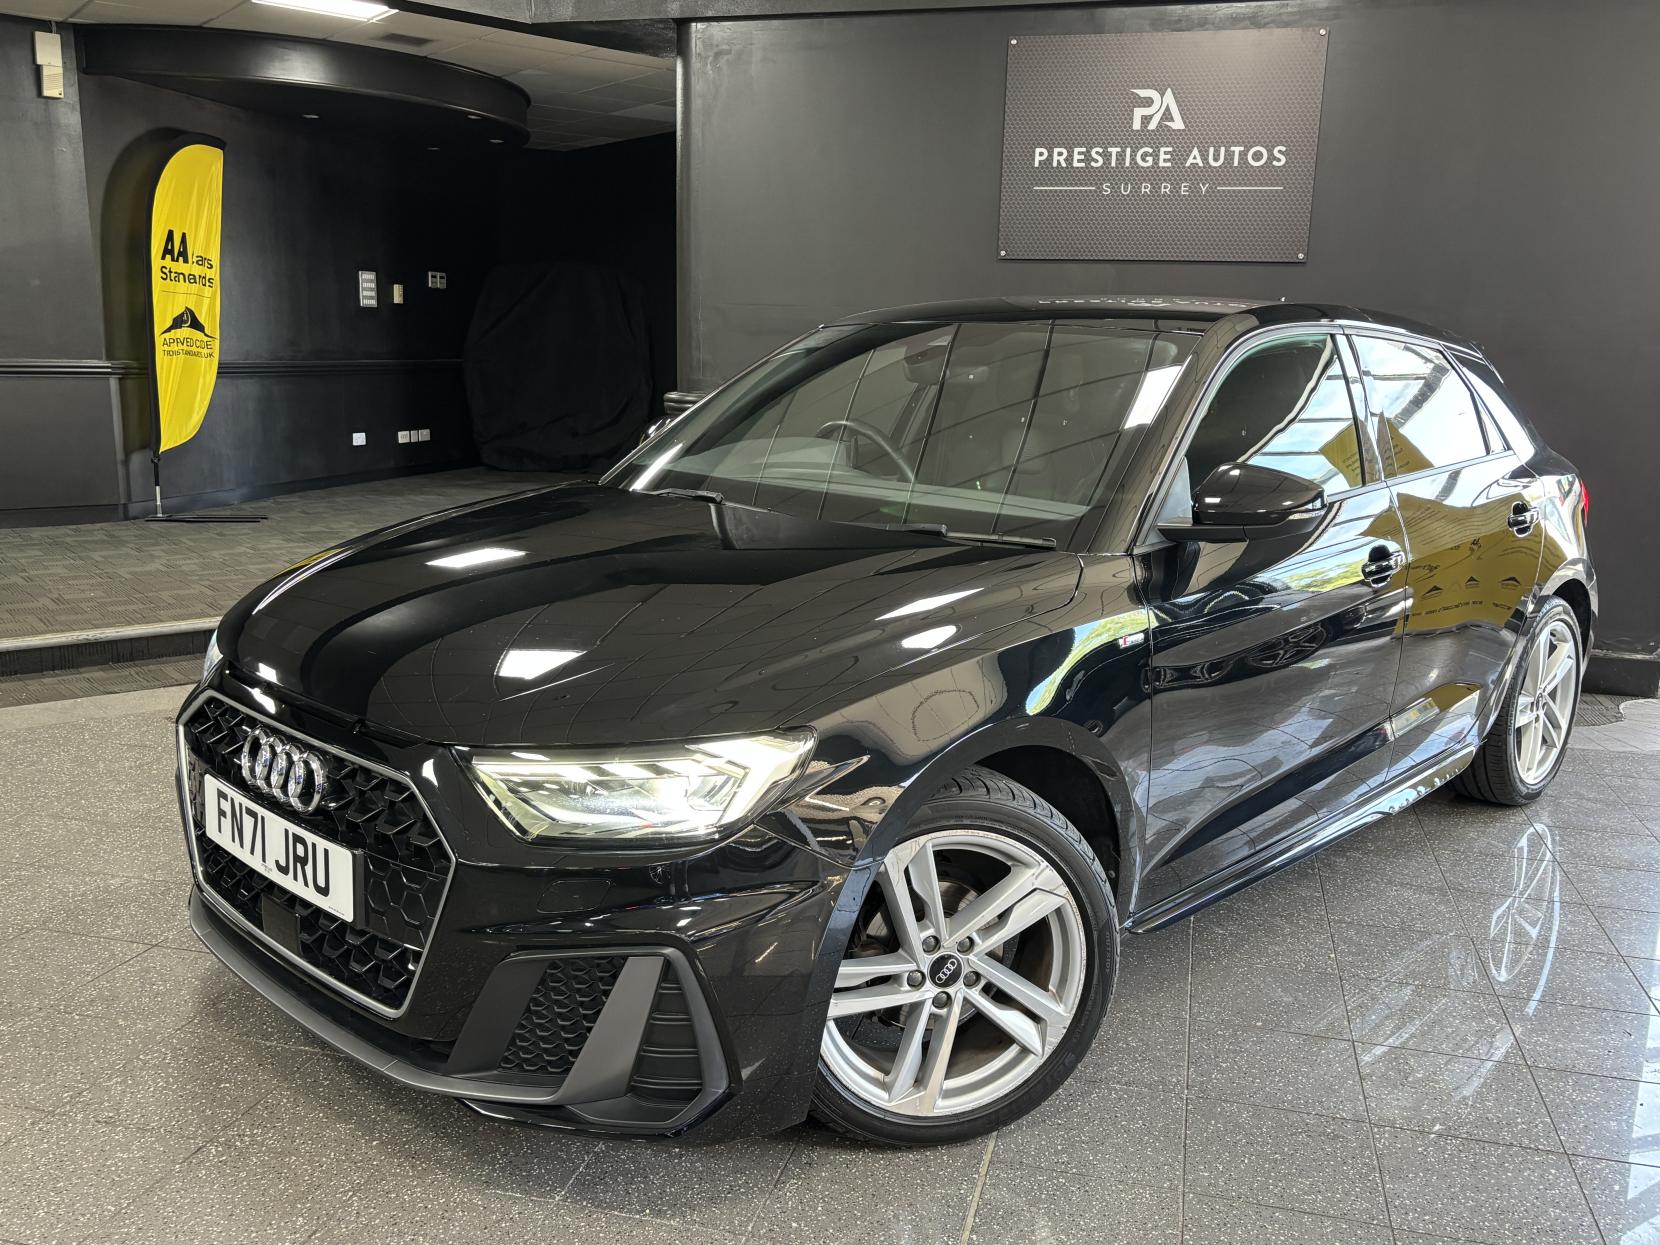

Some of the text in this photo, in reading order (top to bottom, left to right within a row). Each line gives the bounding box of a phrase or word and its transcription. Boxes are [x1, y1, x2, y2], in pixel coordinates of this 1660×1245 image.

[1129, 87, 1186, 131] PA
[1033, 145, 1287, 168] PRESTIGE AUTOS
[1101, 182, 1210, 196] SURREY
[160, 228, 190, 265] AA
[216, 787, 330, 898] FN71 JRU
